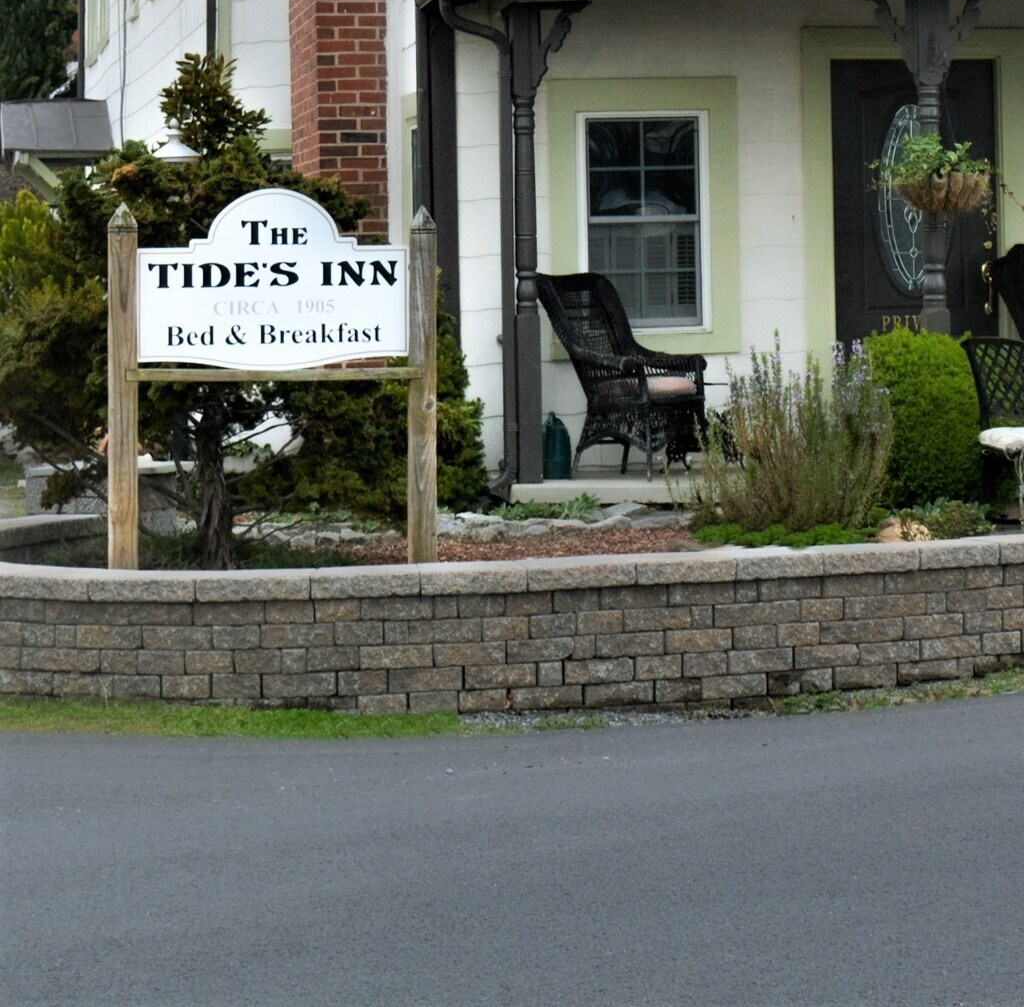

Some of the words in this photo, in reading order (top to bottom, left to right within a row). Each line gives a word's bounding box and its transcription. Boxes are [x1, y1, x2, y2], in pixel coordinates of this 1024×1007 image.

[148, 262, 299, 288] TIDE'S
[320, 260, 398, 287] INN
[213, 300, 280, 315] CIRCA
[296, 298, 336, 314] 1905
[167, 325, 214, 346] Bed
[225, 324, 248, 345] &
[259, 323, 382, 345] Breakfast
